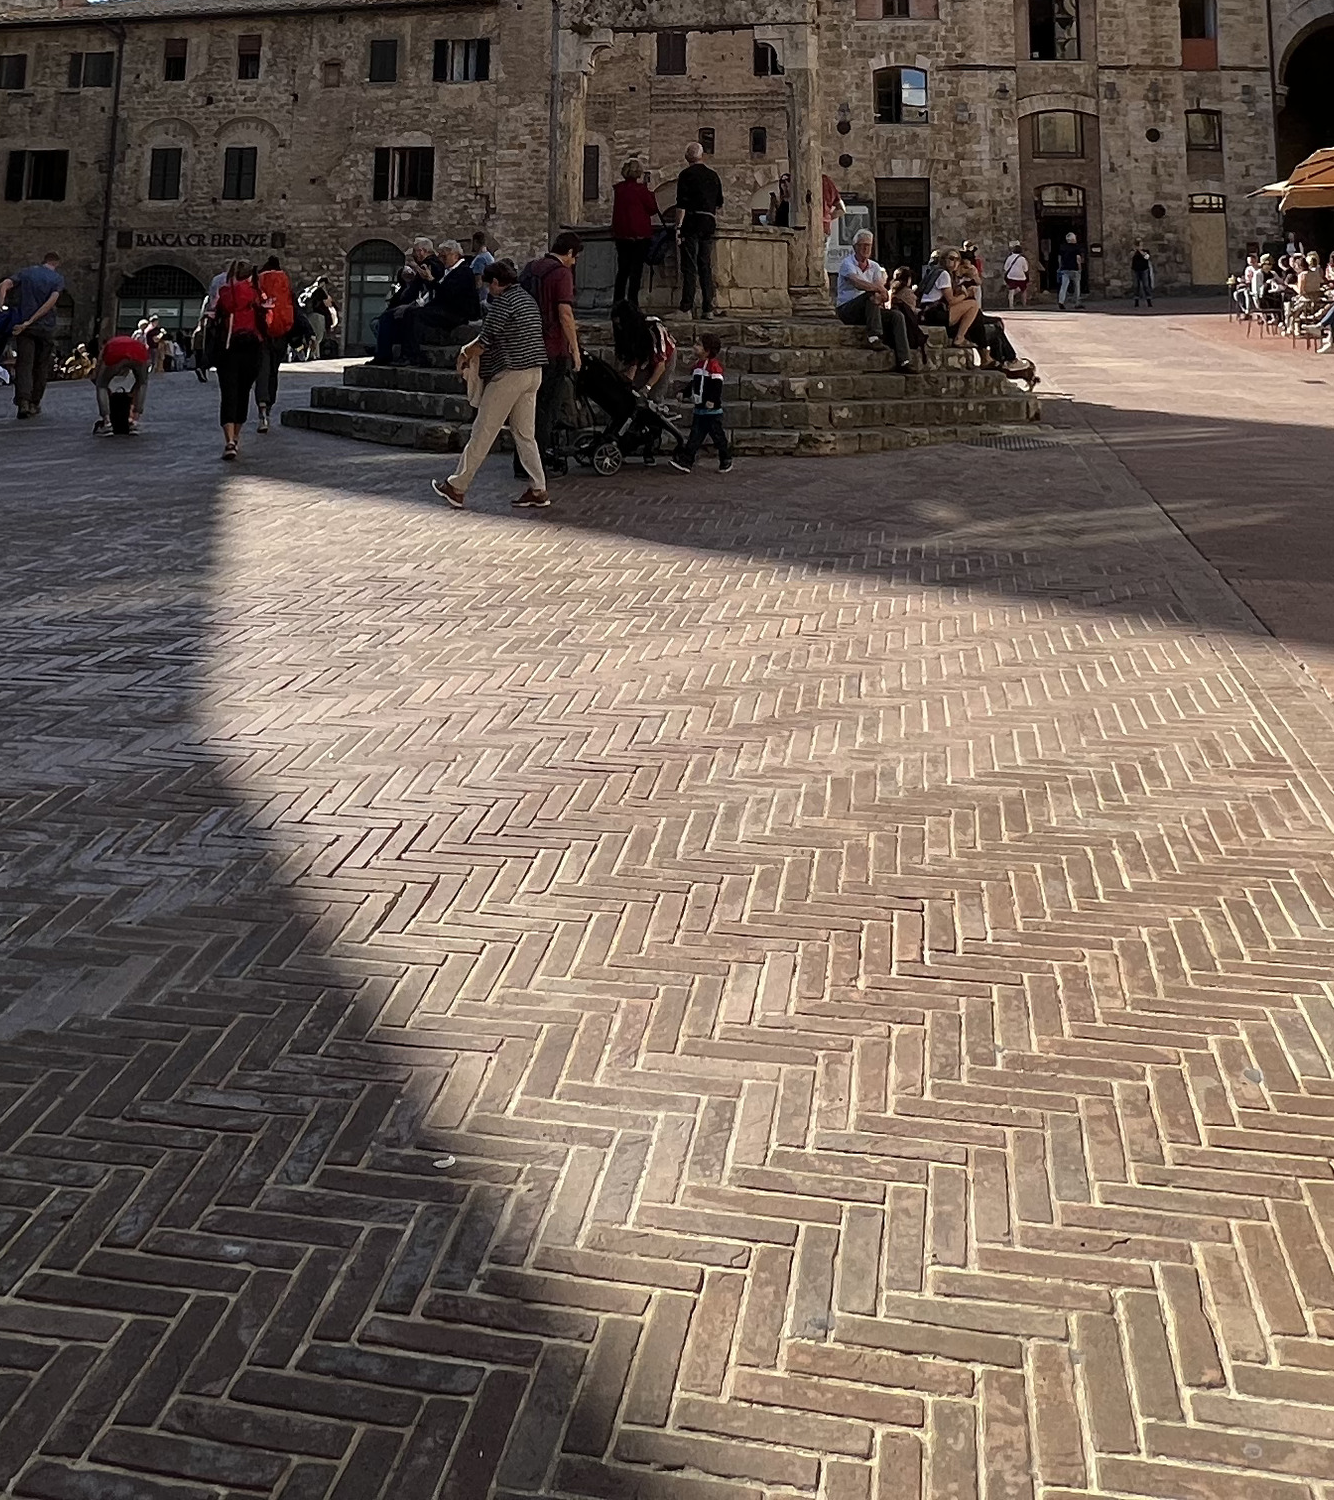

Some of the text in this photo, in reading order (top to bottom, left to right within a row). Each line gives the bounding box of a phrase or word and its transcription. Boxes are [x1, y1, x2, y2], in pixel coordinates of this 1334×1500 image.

[136, 233, 267, 247] BANCA CR FIRENZE
